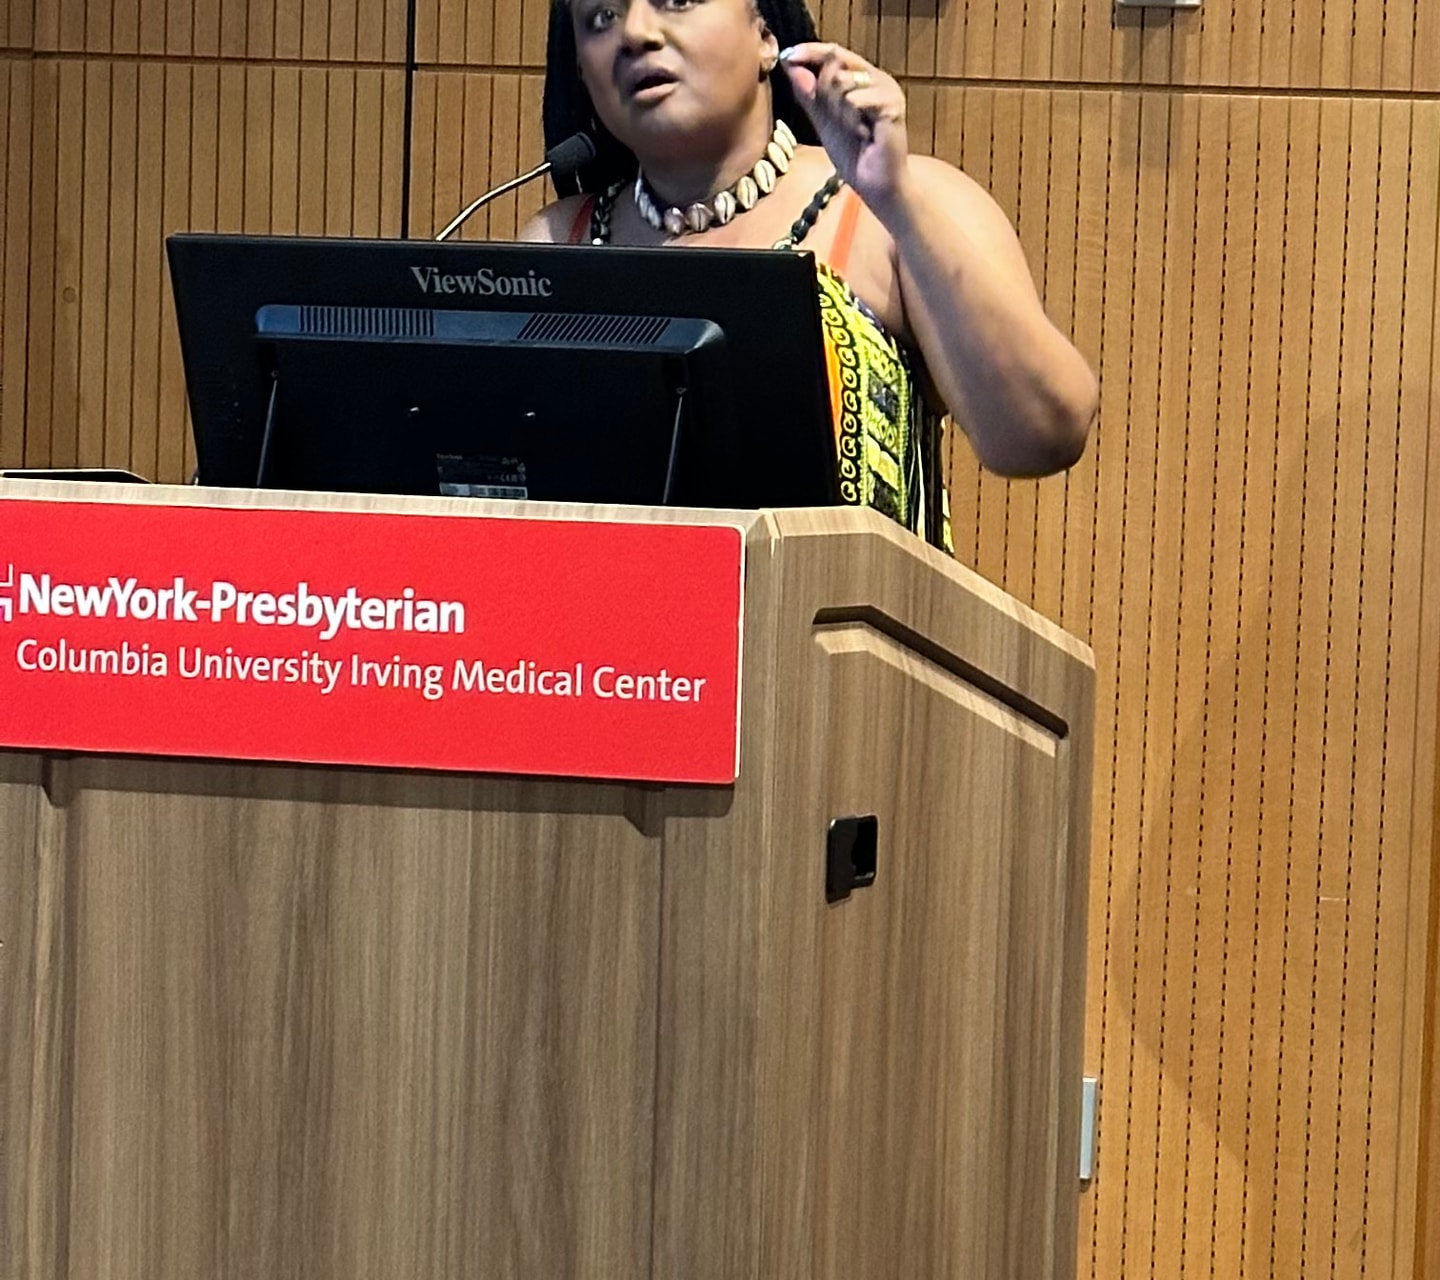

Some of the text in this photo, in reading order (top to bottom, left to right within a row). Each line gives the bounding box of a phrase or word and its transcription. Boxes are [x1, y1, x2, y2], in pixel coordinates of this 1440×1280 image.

[408, 265, 553, 298] ViewSonic
[18, 572, 466, 640] NewYork-Presbyterian
[16, 637, 707, 702] Columbia University Irving Medical Center
